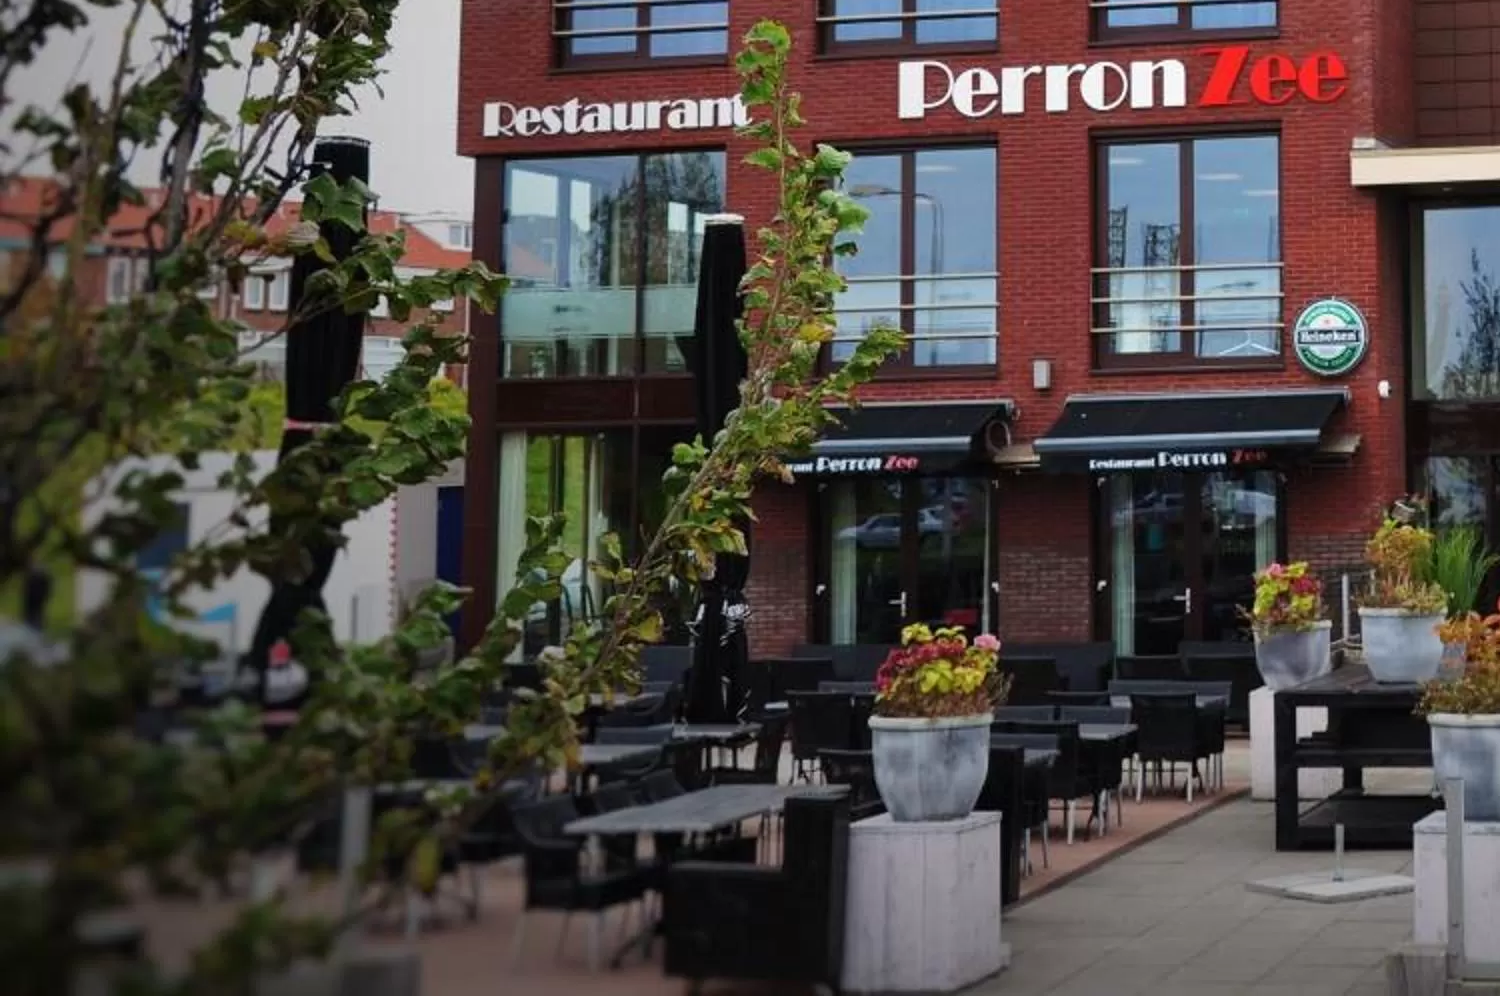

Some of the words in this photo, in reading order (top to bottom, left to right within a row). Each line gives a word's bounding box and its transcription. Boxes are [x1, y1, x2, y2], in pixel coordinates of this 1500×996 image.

[898, 59, 1186, 119] Perron
[1198, 46, 1350, 108] Zee
[483, 94, 753, 138] Restaurant
[815, 455, 882, 472] Perron
[884, 454, 920, 470] Zee
[1157, 451, 1227, 468] Perron
